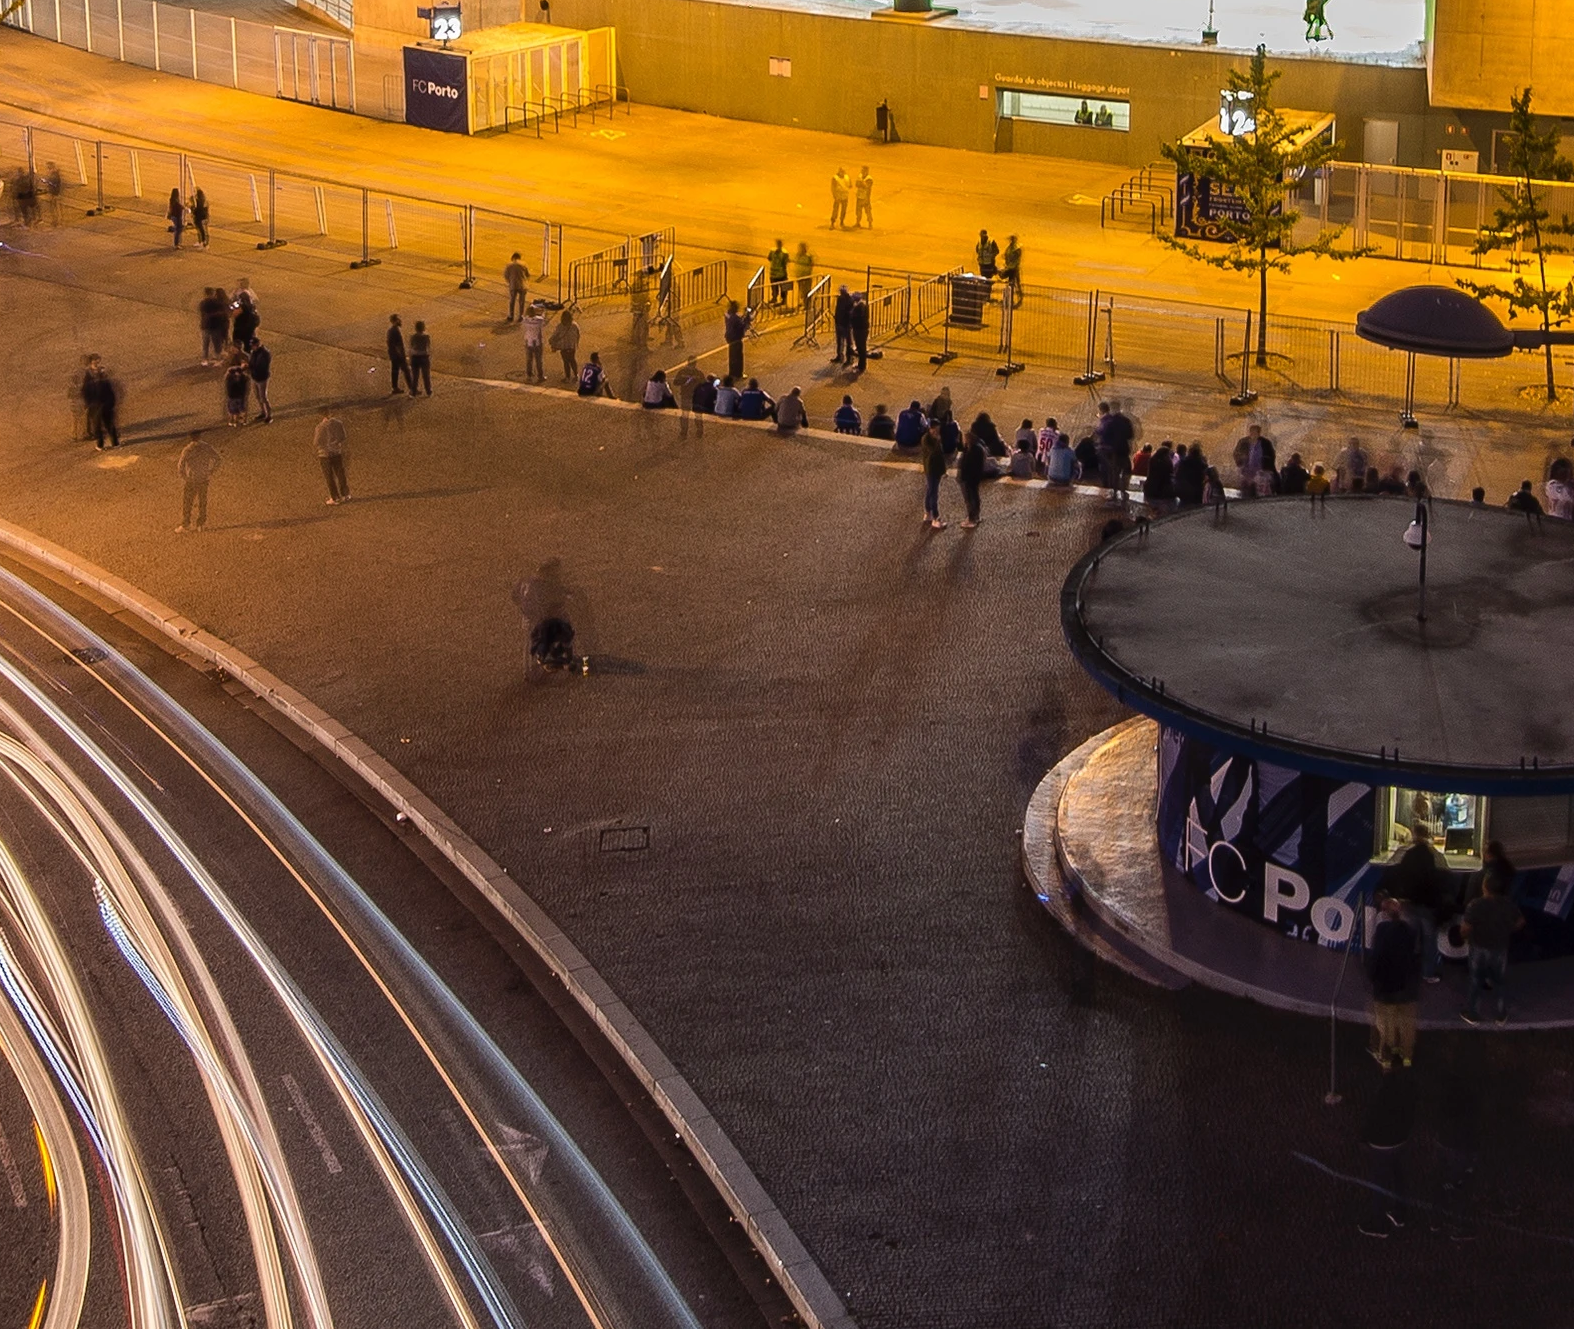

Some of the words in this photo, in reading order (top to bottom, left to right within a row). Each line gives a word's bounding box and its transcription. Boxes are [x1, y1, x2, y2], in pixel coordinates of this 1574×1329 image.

[434, 17, 461, 40] 23
[427, 81, 459, 99] Porto
[1208, 208, 1251, 221] PORTO
[581, 368, 594, 384] 12
[1039, 437, 1053, 451] 50
[1184, 816, 1247, 904] FC
